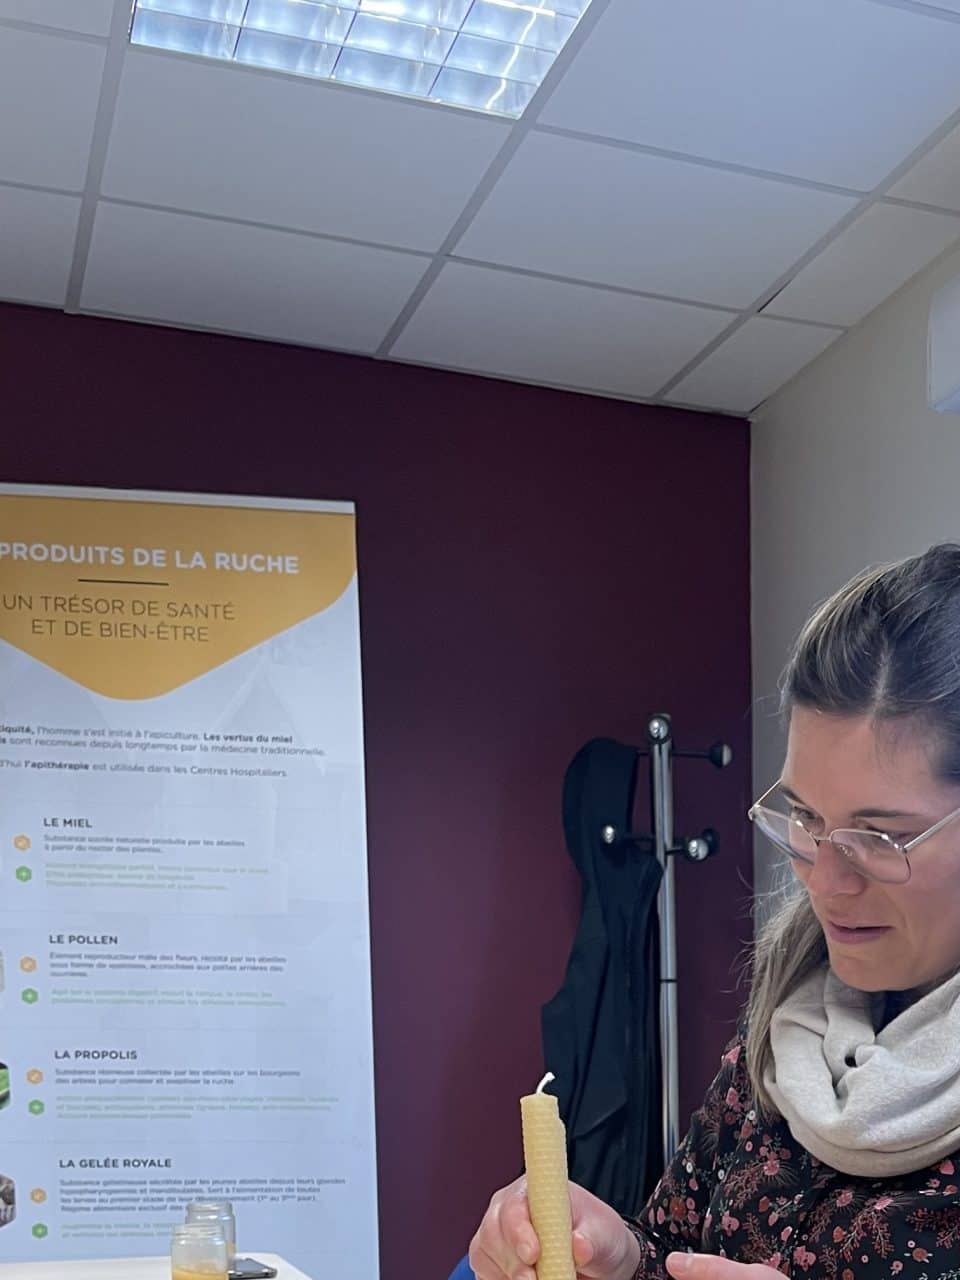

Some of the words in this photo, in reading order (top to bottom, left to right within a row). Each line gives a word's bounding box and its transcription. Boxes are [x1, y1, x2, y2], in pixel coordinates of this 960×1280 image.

[0, 542, 125, 566] PRODUITS
[133, 547, 167, 568] DE
[175, 550, 207, 569] LA
[215, 552, 300, 574] RUCHE
[3, 594, 33, 611] UN
[40, 594, 125, 615] TRÉSOR
[131, 599, 161, 617] DE
[167, 601, 236, 621] SANTÉ
[31, 618, 57, 636] ET
[64, 620, 94, 638] DE
[203, 732, 220, 742] Les
[223, 733, 253, 743] vertus
[256, 733, 269, 743] du
[271, 734, 293, 744] miel
[43, 818, 59, 828] LE
[63, 818, 93, 828] MIEL
[49, 934, 64, 944] LE
[68, 935, 118, 945] POLLEN
[55, 1050, 71, 1060] LA
[74, 1049, 138, 1060] PROPOLIS
[59, 1159, 75, 1168] LA
[79, 1157, 119, 1168] GELÉE
[122, 1159, 172, 1168] ROYALE
